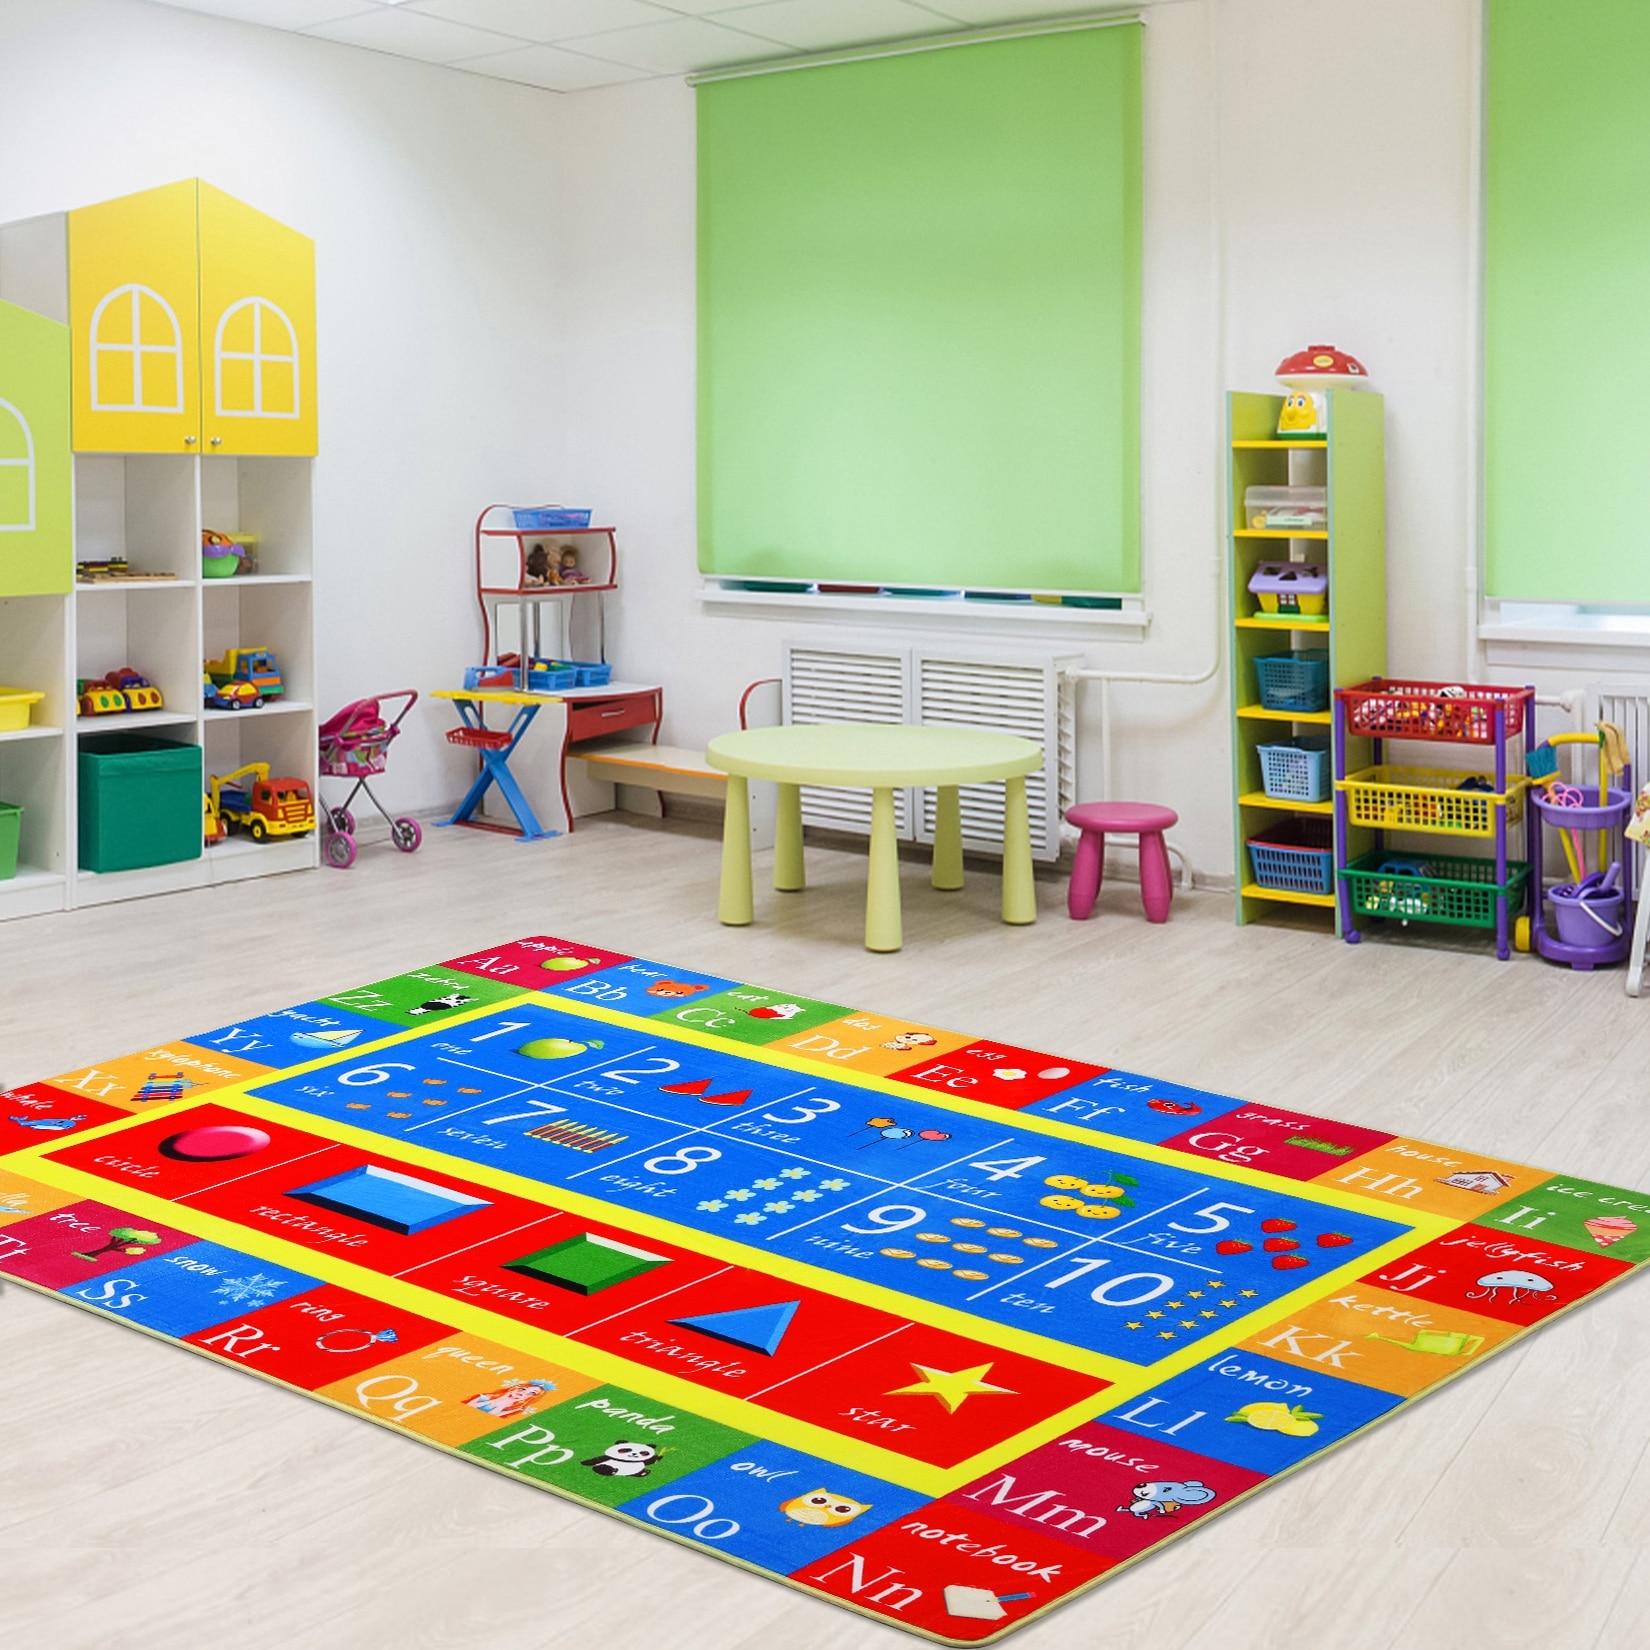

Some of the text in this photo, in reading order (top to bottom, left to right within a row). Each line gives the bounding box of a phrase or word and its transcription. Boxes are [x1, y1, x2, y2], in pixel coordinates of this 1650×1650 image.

[517, 941, 574, 955] apple
[457, 957, 520, 975] Aa
[619, 964, 668, 977] bear
[407, 973, 470, 990] zebra
[562, 979, 628, 1001] Bb
[329, 990, 393, 1011] Zz
[727, 991, 769, 1002] cat
[267, 1010, 342, 1026] yacht
[676, 1008, 735, 1028] Cc
[209, 1027, 273, 1053] Yy
[469, 1022, 531, 1042] 1
[431, 1042, 472, 1055] one
[787, 1034, 872, 1061] Dd
[53, 1069, 127, 1097] Xx
[337, 1063, 416, 1086] 6
[600, 1058, 680, 1084] 2
[910, 1064, 978, 1088] Ee
[295, 1085, 334, 1097] six
[574, 1080, 625, 1095] two
[1091, 1078, 1151, 1093] fish
[0, 1091, 57, 1110] whale
[482, 1100, 568, 1125] 7
[762, 1098, 841, 1124] 3
[1041, 1097, 1126, 1120] Ff
[731, 1121, 801, 1144] three
[1236, 1112, 1311, 1131] grass
[437, 1127, 507, 1149] seven
[1188, 1132, 1270, 1163] Gg
[93, 1155, 160, 1178] circle
[643, 1146, 722, 1175] 8
[968, 1156, 1048, 1181] 4
[1385, 1144, 1462, 1168] house
[600, 1174, 677, 1197] eight
[915, 1178, 1002, 1198] four
[1331, 1166, 1423, 1199] Hh
[1546, 1183, 1650, 1213] ice cre
[50, 1213, 101, 1233] tree
[249, 1205, 369, 1248] rectangle
[840, 1204, 927, 1234] 9
[1167, 1201, 1255, 1234] 5
[1494, 1204, 1556, 1230] Ii
[803, 1236, 875, 1259] nine
[1120, 1232, 1202, 1253] five
[1440, 1235, 1586, 1272] jellyfish
[163, 1256, 228, 1277] snow
[1379, 1262, 1447, 1291] Jj
[76, 1279, 149, 1309] Ss
[452, 1275, 550, 1310] square
[1044, 1257, 1175, 1307] 10
[290, 1301, 345, 1322] ring
[1000, 1292, 1055, 1314] ten
[1328, 1294, 1434, 1328] kettle
[198, 1323, 281, 1358] Rr
[1257, 1324, 1365, 1369] Kk
[422, 1346, 514, 1375] queen
[619, 1330, 747, 1379] triangle
[1207, 1354, 1313, 1398] lemon
[355, 1375, 443, 1422] Qq
[575, 1398, 675, 1435] panda
[838, 1407, 917, 1432] star
[1113, 1396, 1207, 1436] Ll
[486, 1423, 575, 1469] Pp
[1058, 1438, 1160, 1473] mouse
[730, 1461, 799, 1483] owl
[647, 1494, 740, 1540] Oo
[962, 1472, 1108, 1540] Mm
[901, 1521, 1063, 1583] notebook
[809, 1551, 923, 1612] Nn
